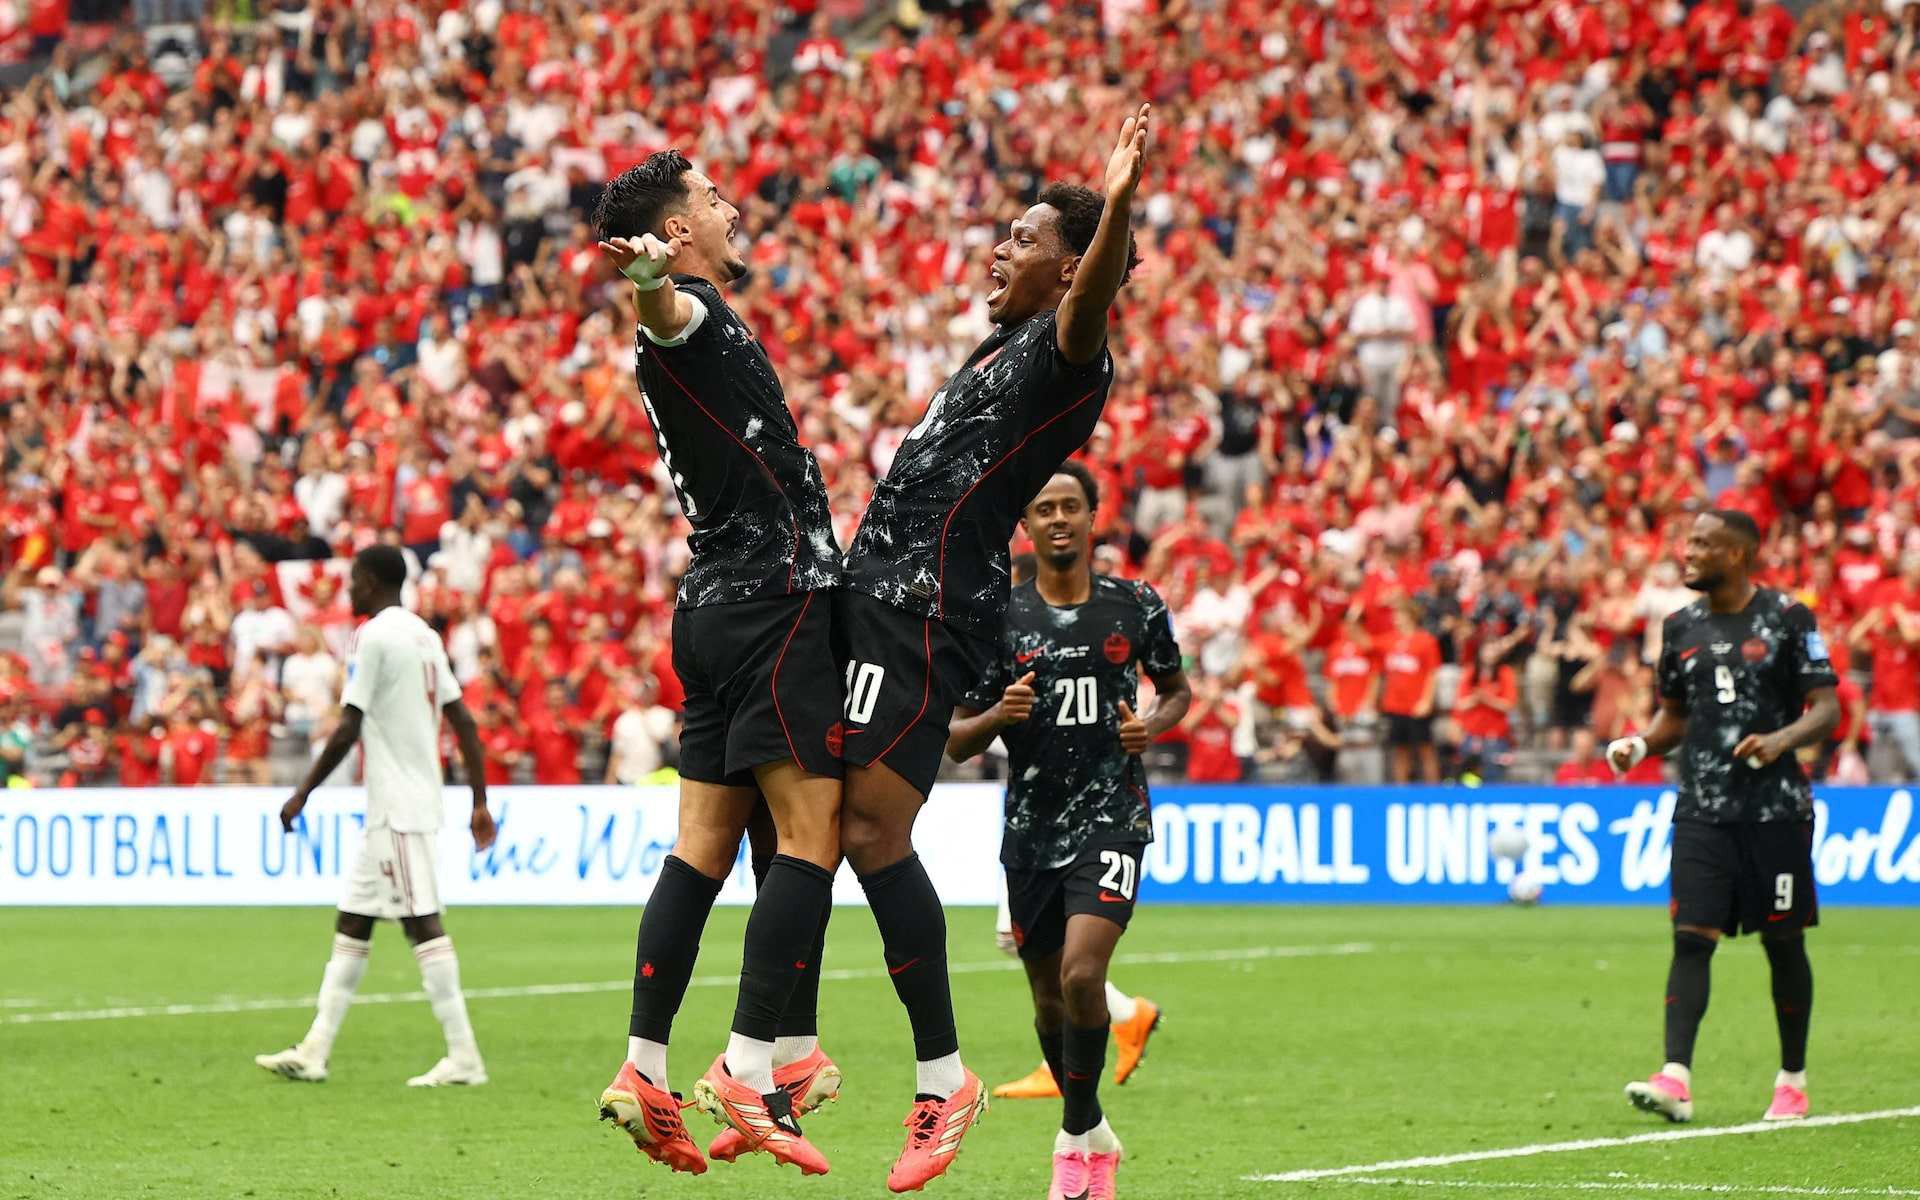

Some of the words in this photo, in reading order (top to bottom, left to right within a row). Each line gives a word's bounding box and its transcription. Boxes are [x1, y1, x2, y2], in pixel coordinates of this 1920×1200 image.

[843, 659, 885, 724] 10
[1055, 676, 1098, 726] 20
[1715, 665, 1736, 704] 9
[1140, 803, 1370, 884] OTBALL
[1386, 803, 1599, 885] UNITES
[379, 860, 397, 887] 4
[1098, 850, 1136, 900] 20
[1774, 873, 1794, 911] 9
